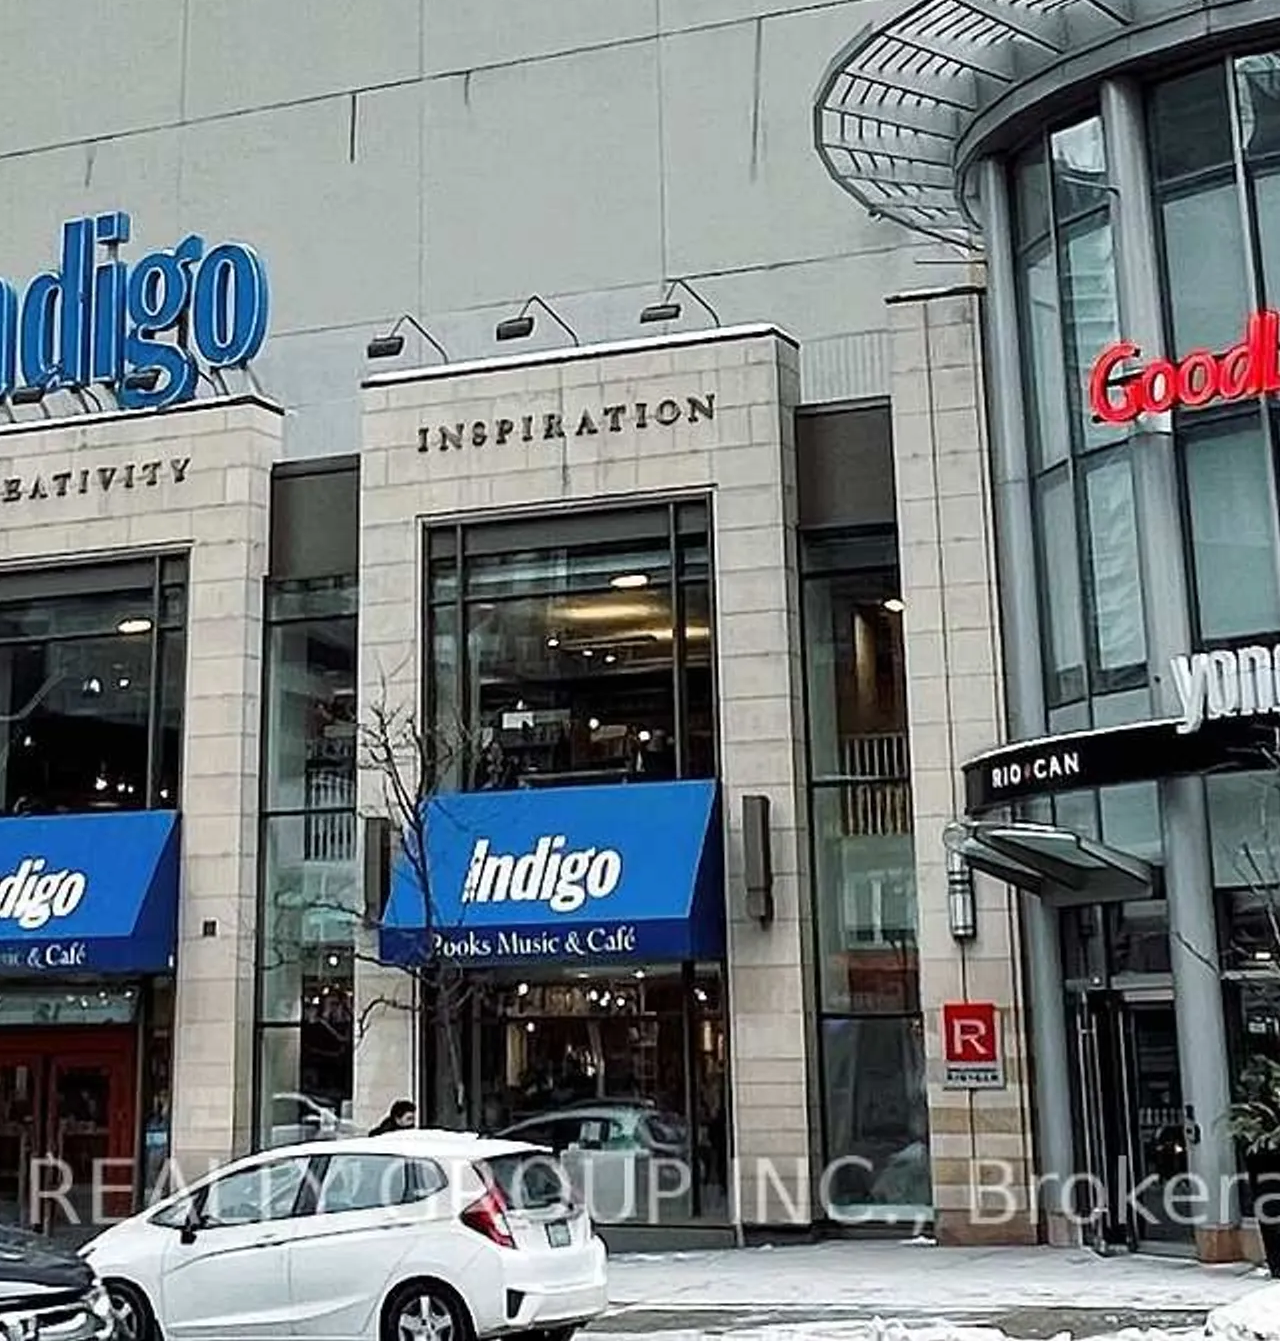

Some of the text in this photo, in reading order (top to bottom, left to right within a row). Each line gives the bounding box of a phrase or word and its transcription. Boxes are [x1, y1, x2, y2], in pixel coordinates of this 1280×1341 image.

[417, 394, 716, 452] INSPIRATION
[461, 835, 622, 913] Indigo
[26, 947, 47, 969] &
[45, 941, 88, 966] Café
[496, 930, 560, 956] Music
[564, 931, 587, 956] &
[586, 925, 636, 953] Café
[952, 1018, 989, 1055] R
